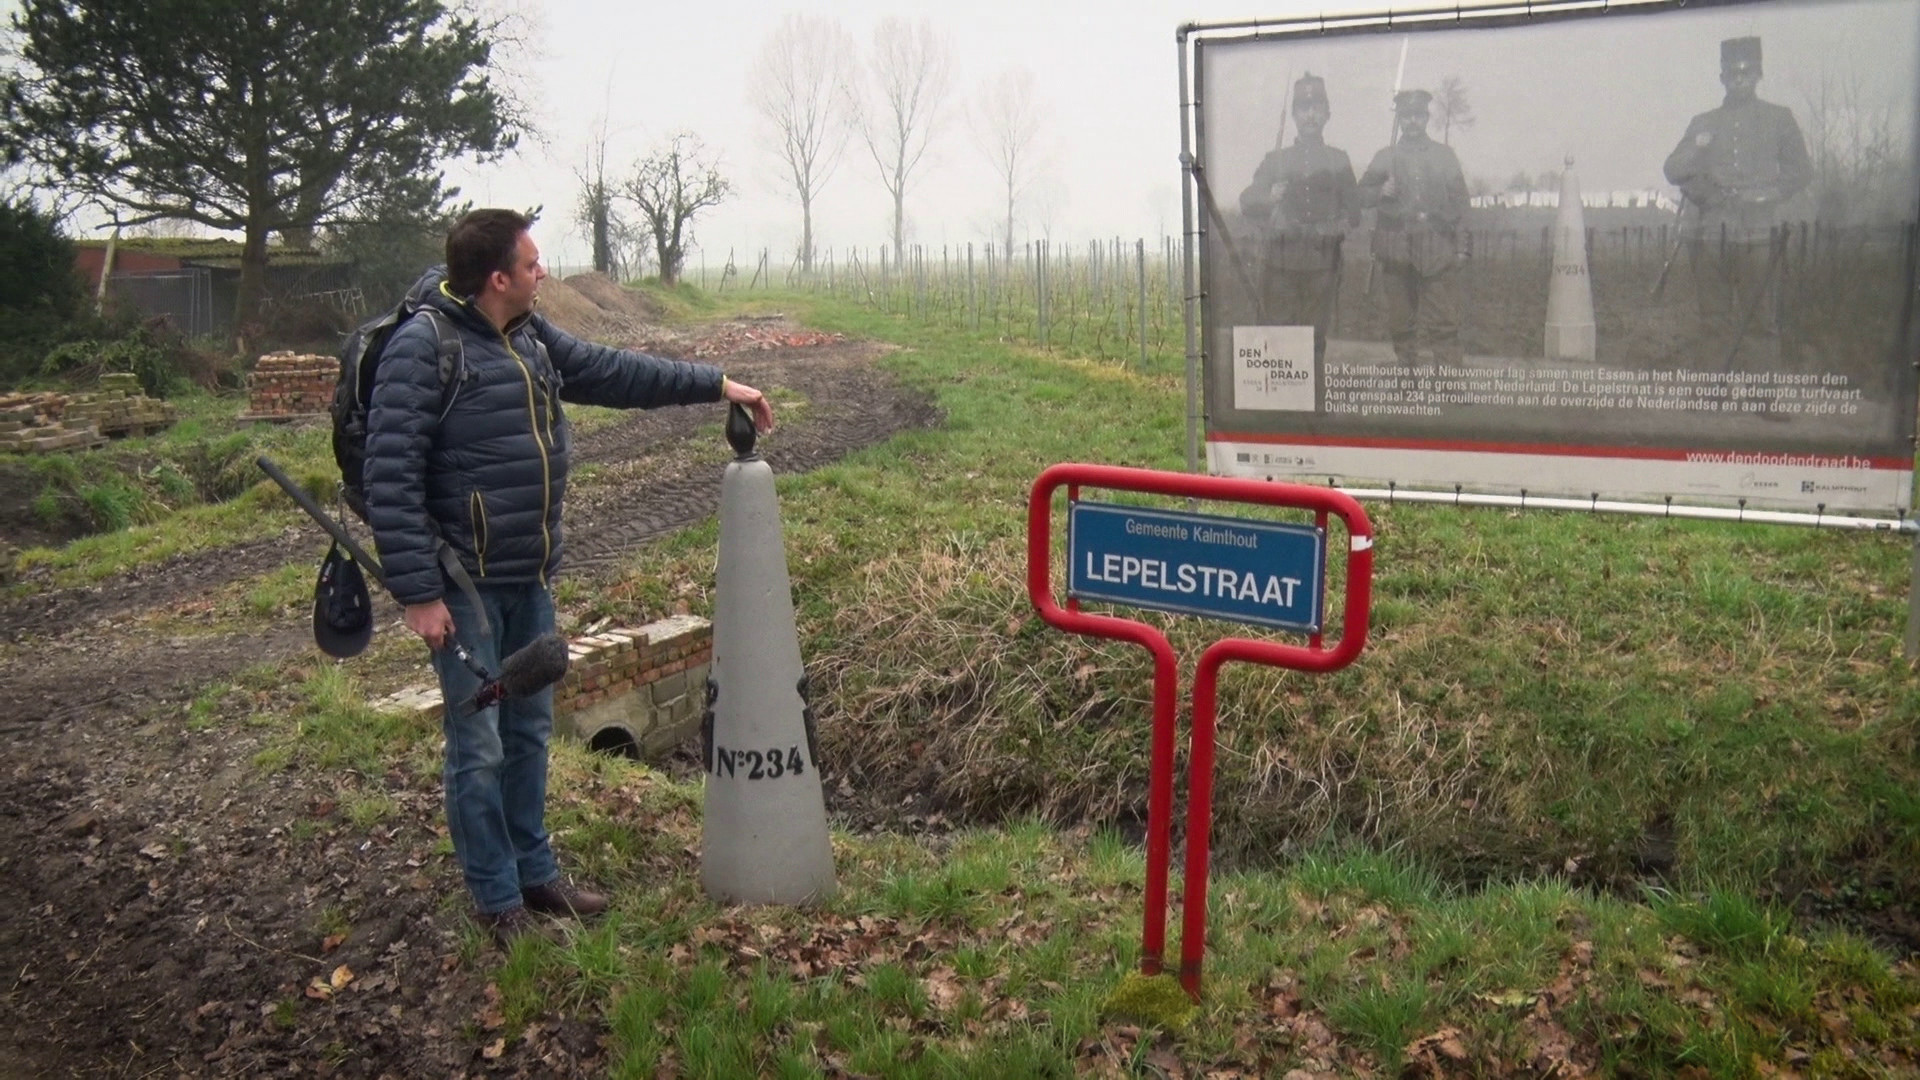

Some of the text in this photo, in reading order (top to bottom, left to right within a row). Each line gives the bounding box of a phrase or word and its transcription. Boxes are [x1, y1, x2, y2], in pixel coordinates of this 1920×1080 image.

[1239, 348, 1261, 358] DEN
[1246, 359, 1293, 369] DOODEN
[1324, 363, 1339, 375] De
[1342, 363, 1410, 377] Kalmthoutse
[1412, 365, 1435, 378] wijk
[1439, 365, 1504, 378] Nieuwmoer
[1571, 368, 1595, 380] met
[1598, 368, 1634, 381] Essen
[1638, 369, 1649, 381] in
[1652, 369, 1673, 382] het
[1676, 369, 1770, 384] Niemandsland
[1773, 372, 1818, 385] tussen
[1822, 372, 1848, 385] den
[1270, 370, 1309, 380] DRAAD
[1324, 376, 1397, 388] Doodendraad
[1401, 379, 1414, 389] en
[1417, 378, 1431, 390] de
[1435, 380, 1467, 392] grens
[1470, 380, 1491, 391] met
[1563, 380, 1579, 393] De
[1583, 381, 1651, 397] Lepelstraat
[1655, 383, 1665, 396] is
[1668, 386, 1692, 397] een
[1695, 385, 1728, 397] oude
[1731, 385, 1797, 400] gedempte
[1324, 389, 1857, 416] Aan grenspaal 234 patrouilleerden aan de overzijde de Nederlandse en aan deze zijde de
[1324, 401, 1444, 416] Duitse grenswachten.
[1686, 450, 1871, 469] www.dendoodendraad.be
[1125, 518, 1258, 549] Gemeente Kalmthout
[1086, 551, 1301, 608] LEPELSTRAAT
